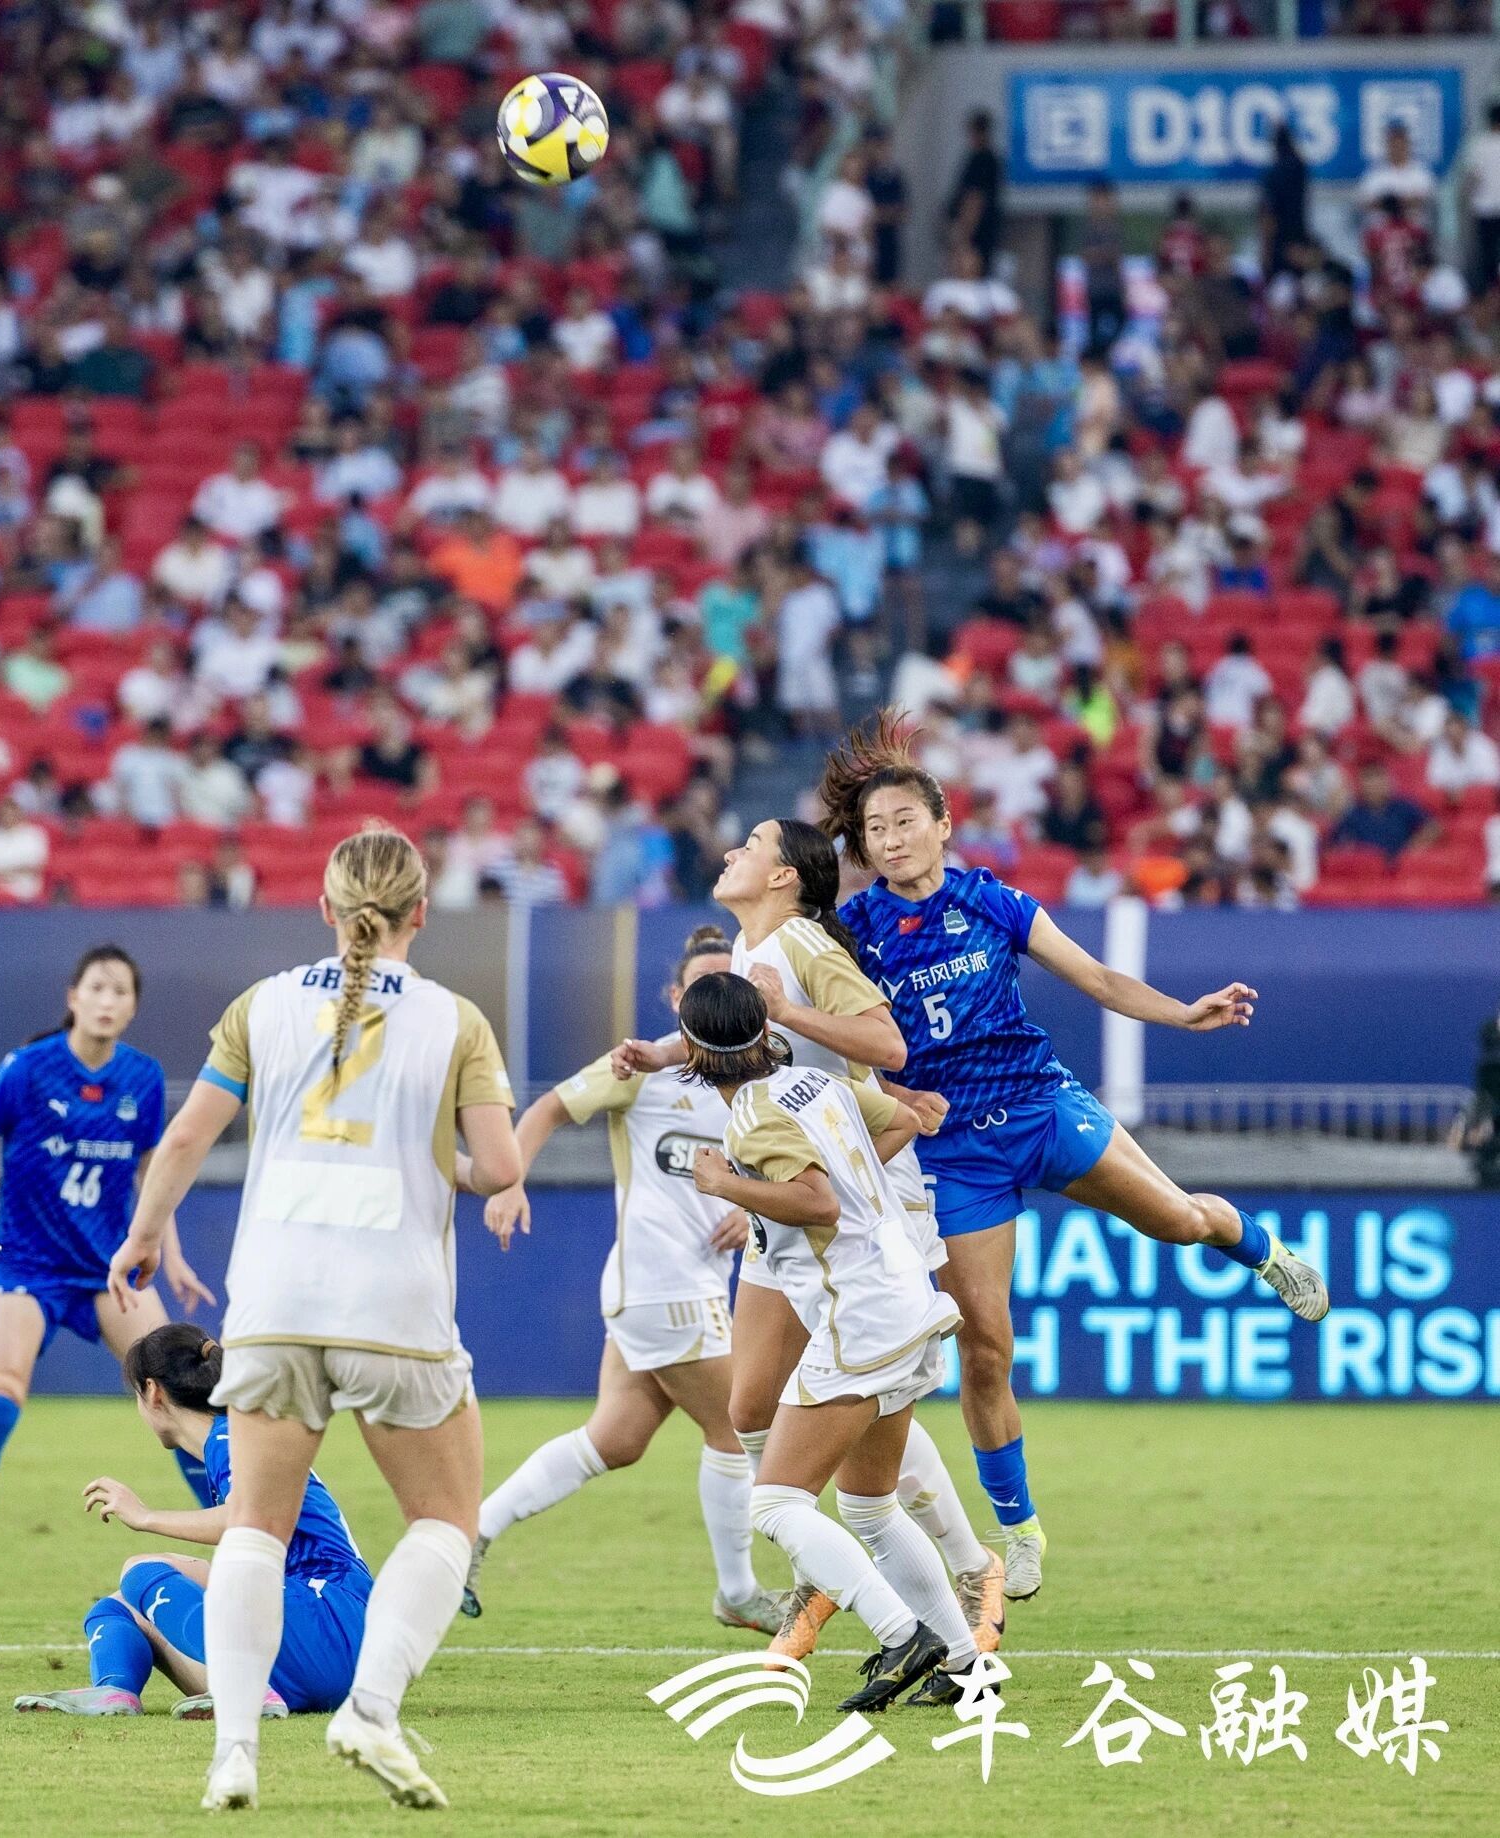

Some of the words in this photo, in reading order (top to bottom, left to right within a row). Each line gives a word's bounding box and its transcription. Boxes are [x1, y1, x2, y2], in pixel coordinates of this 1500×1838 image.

[1127, 83, 1339, 167] D103
[302, 966, 404, 994] GREN
[908, 949, 990, 992] 东风奕派
[922, 992, 953, 1040] 5
[299, 998, 388, 1148] 2
[60, 1161, 104, 1208] 46
[1355, 1206, 1454, 1299] IS
[1081, 1305, 1293, 1399] THE
